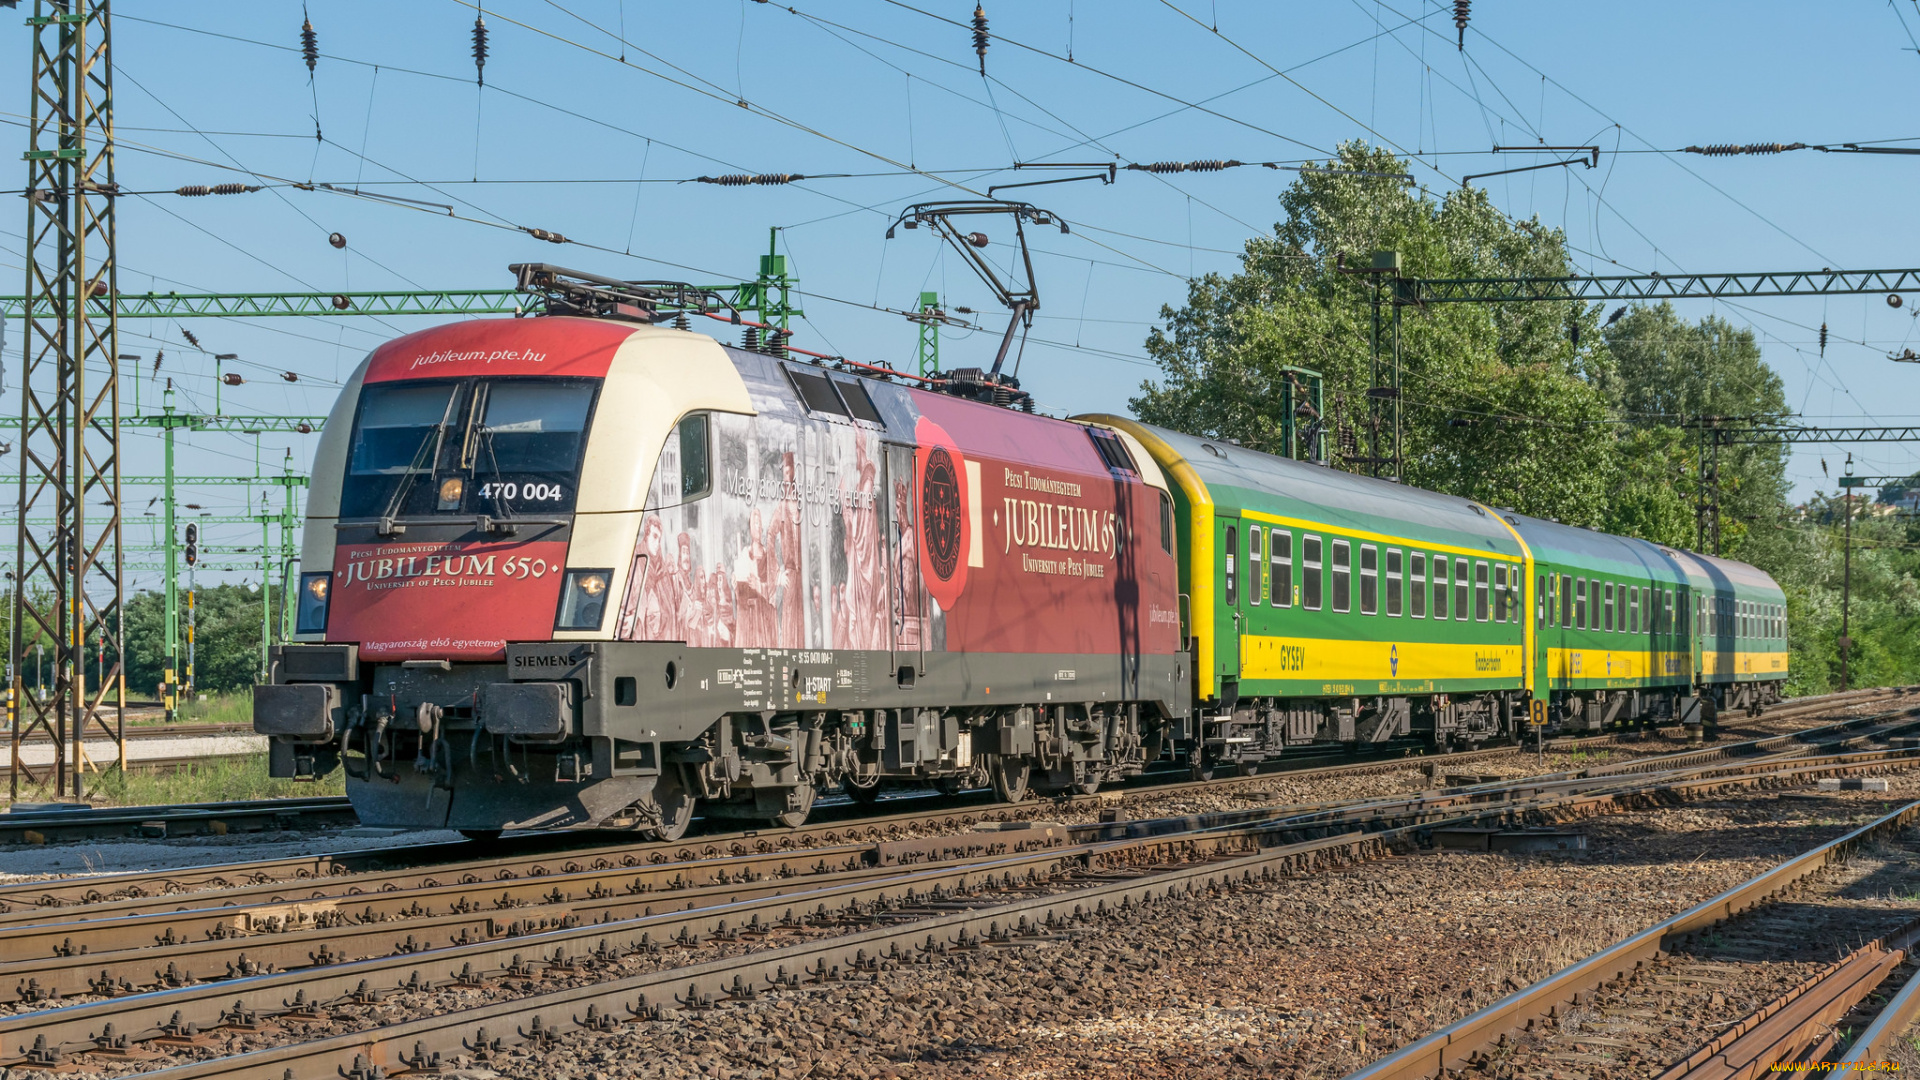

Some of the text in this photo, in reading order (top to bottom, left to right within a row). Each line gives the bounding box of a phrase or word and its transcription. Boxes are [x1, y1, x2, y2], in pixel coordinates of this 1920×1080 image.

[409, 348, 547, 371] jubileum.pte.hu
[478, 483, 562, 501] 470 004
[726, 467, 803, 511] Magyarország
[1003, 497, 1124, 560] JUBILEUM 650
[344, 555, 547, 588] JUBILEUM 650
[1022, 553, 1058, 575] UNIVERSITY
[1083, 558, 1104, 580] JUBILEE
[366, 580, 417, 591] UNIVERSITY
[418, 579, 430, 587] OF
[458, 576, 495, 588] JUBILEE
[365, 638, 428, 652] Magyarország
[430, 638, 450, 648] első
[514, 655, 577, 667] SIEMENS
[1280, 644, 1305, 671] GYSEV
[805, 676, 832, 692] H-START
[1532, 700, 1544, 724] 8
